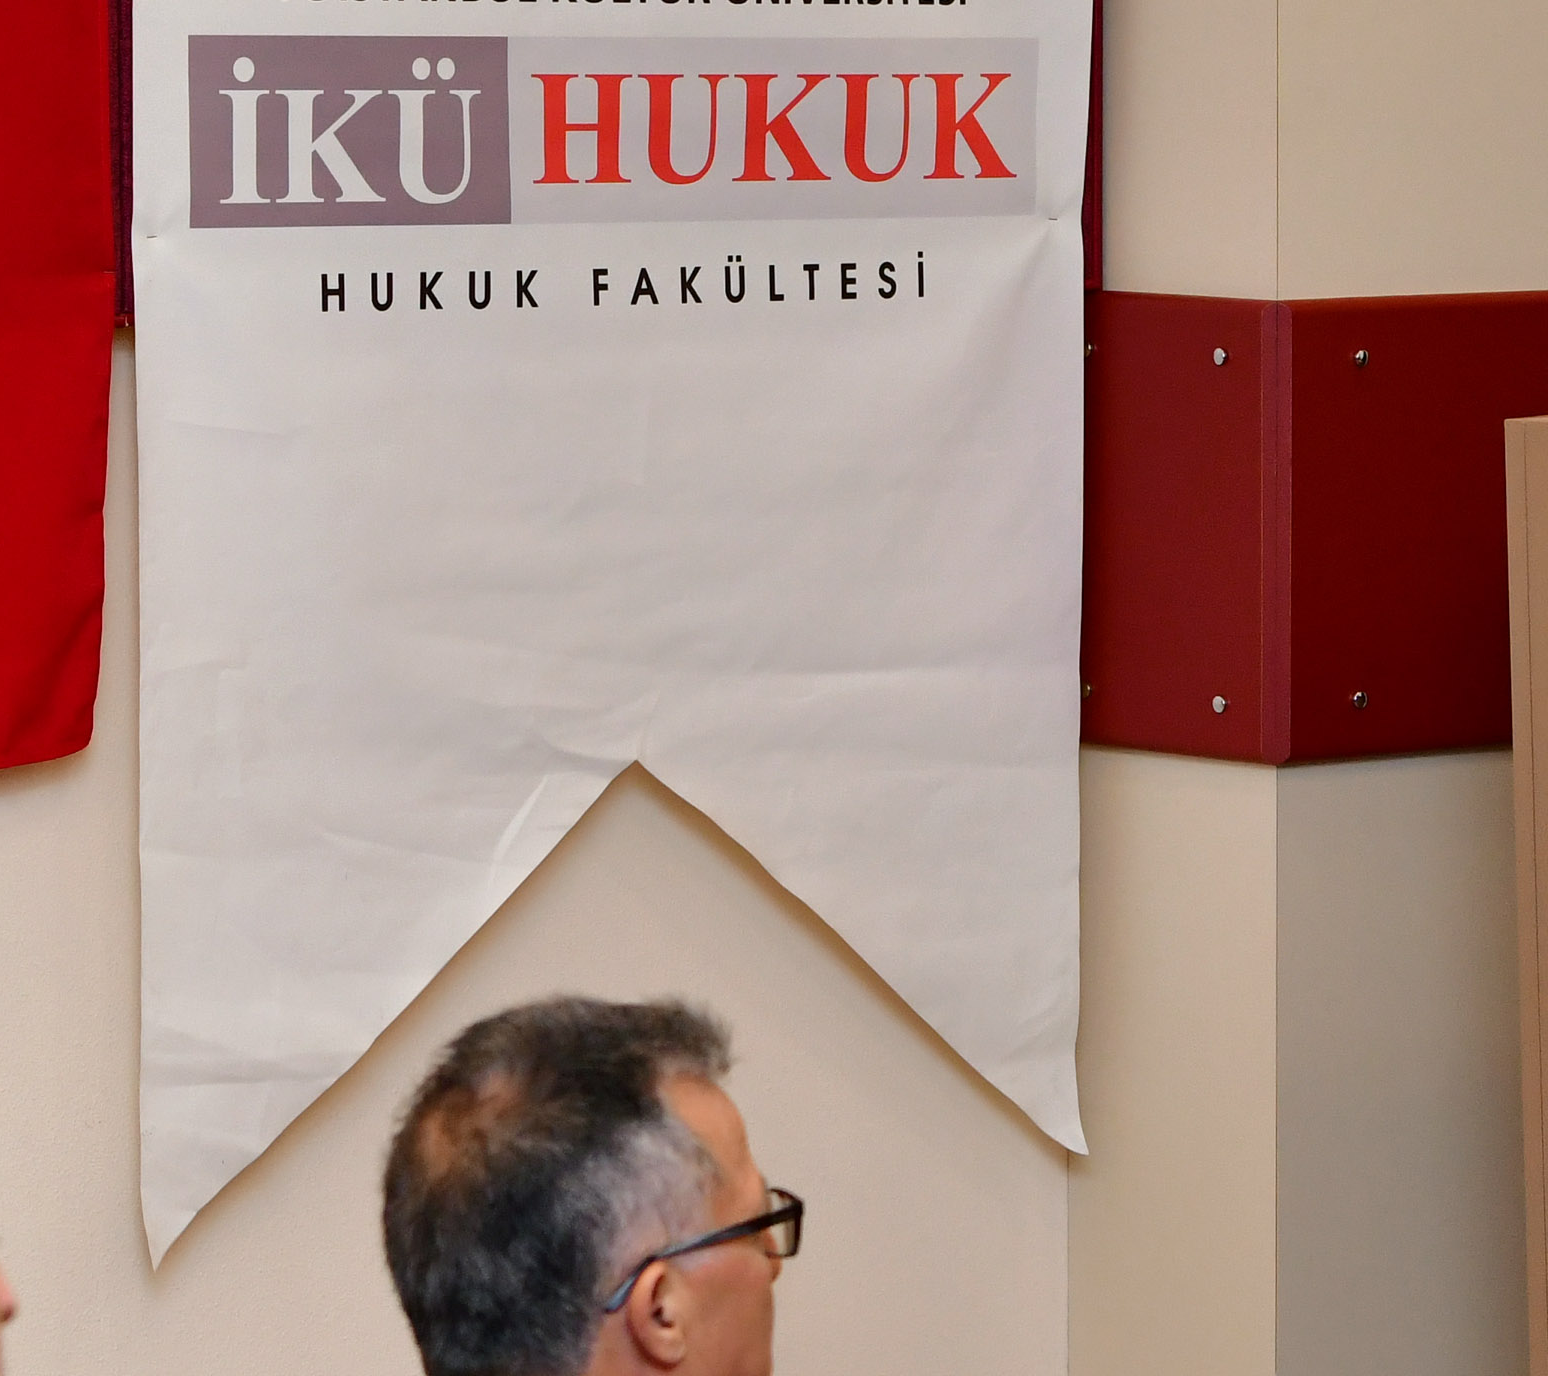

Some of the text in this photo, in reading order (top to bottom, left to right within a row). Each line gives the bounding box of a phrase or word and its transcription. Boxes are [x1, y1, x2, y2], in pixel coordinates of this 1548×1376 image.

[218, 56, 1017, 205] İKÜ HUKUK
[321, 251, 926, 312] HUKUK FAKÜLTESİ
